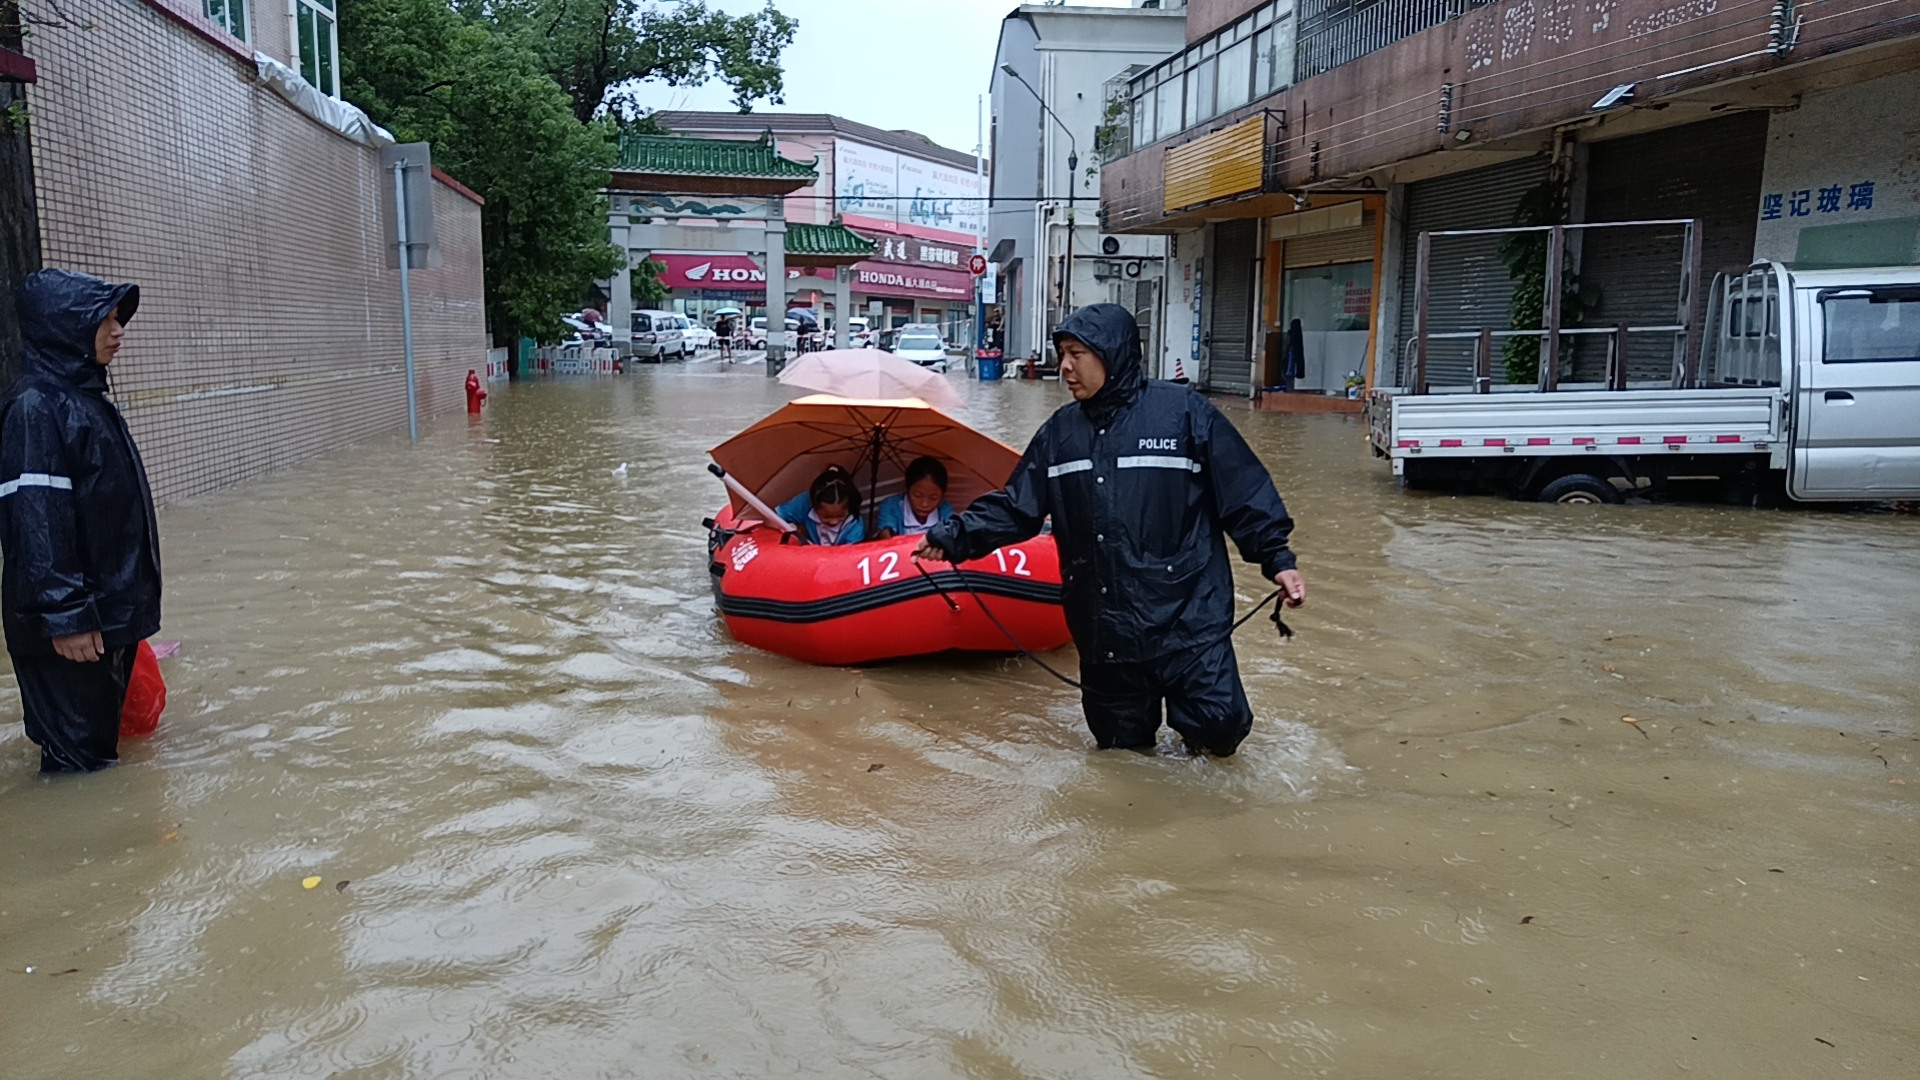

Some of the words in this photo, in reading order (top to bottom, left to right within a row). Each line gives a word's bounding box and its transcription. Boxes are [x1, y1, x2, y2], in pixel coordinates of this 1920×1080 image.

[1761, 180, 1876, 221] 坚记玻璃
[859, 270, 904, 286] HONDA
[1138, 438, 1178, 450] POLICE
[857, 551, 900, 585] 12
[991, 548, 1031, 576] 12
